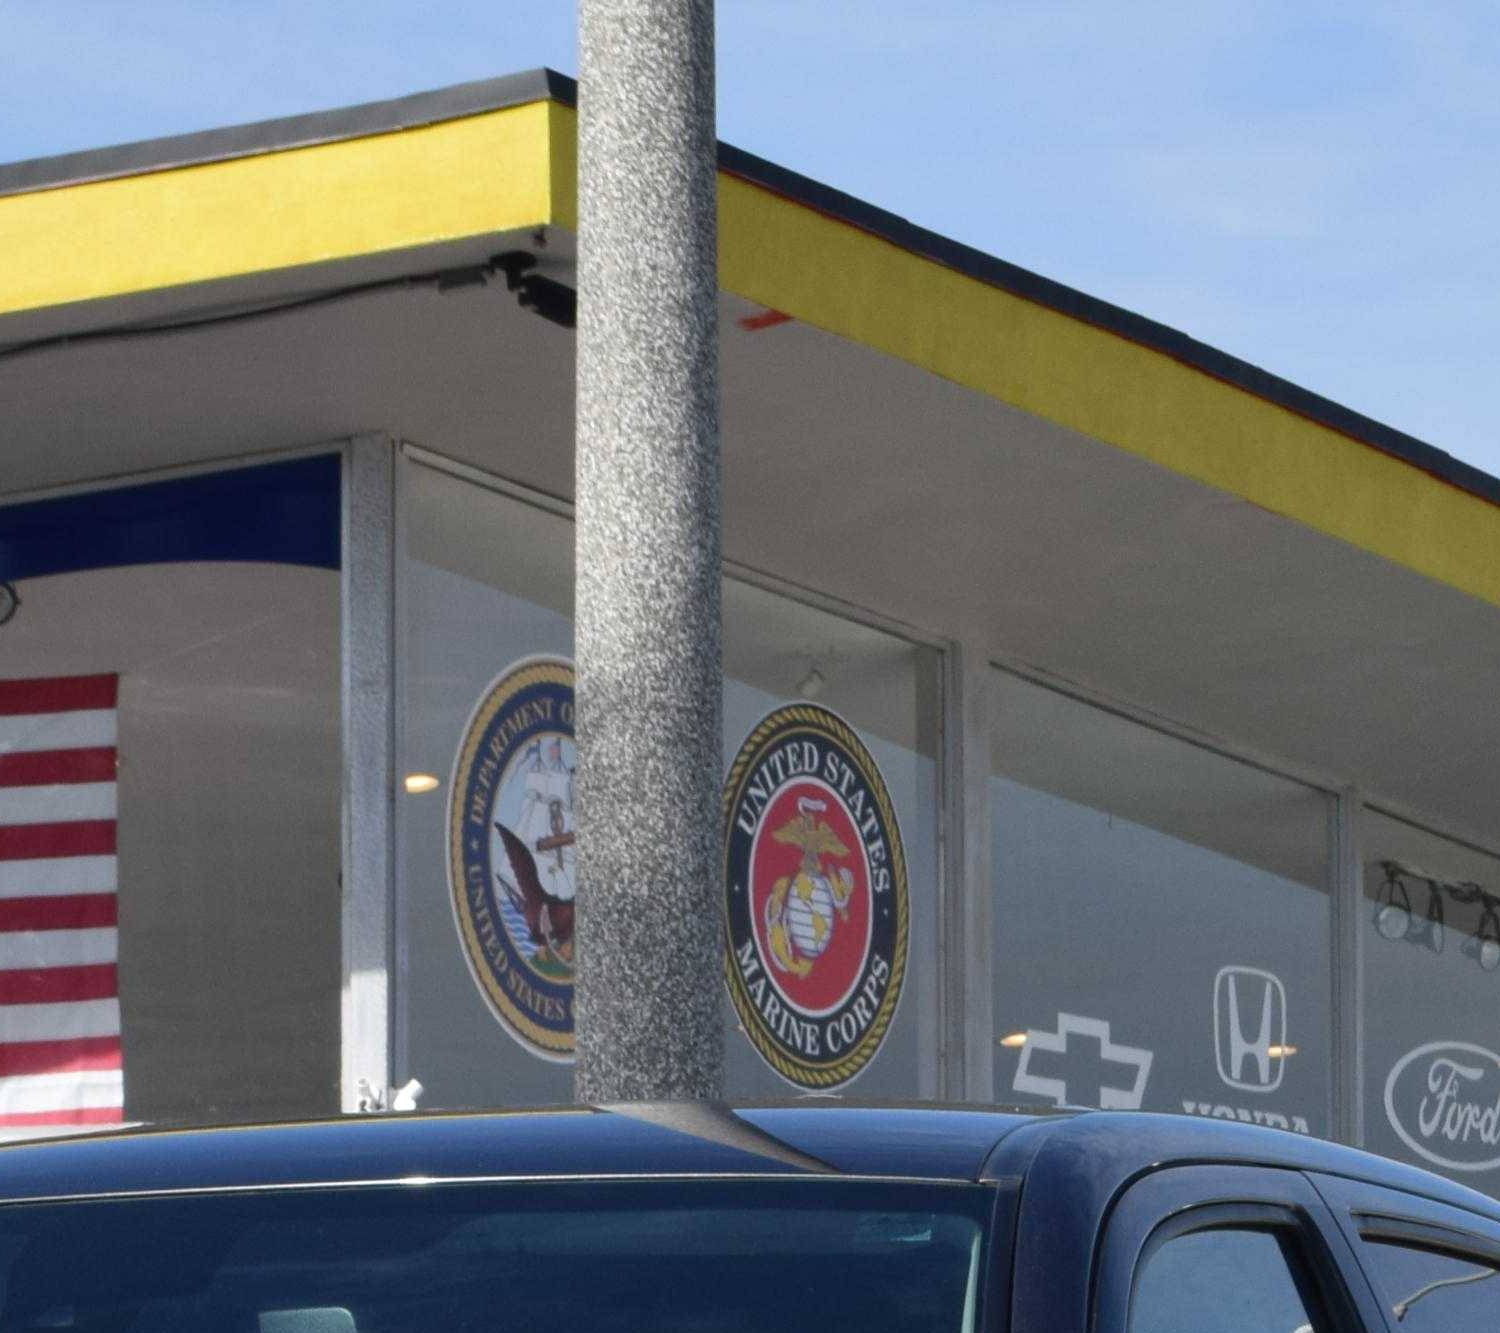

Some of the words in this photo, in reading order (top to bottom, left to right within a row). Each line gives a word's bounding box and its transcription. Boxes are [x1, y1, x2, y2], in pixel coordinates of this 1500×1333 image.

[470, 698, 553, 826] DEPARTMENT
[737, 741, 819, 836] UNITED
[822, 751, 891, 894] STATES
[467, 865, 510, 977] UNITED
[505, 971, 566, 1022] STATES
[737, 938, 821, 1056] MARINE
[825, 953, 891, 1053] CORPS
